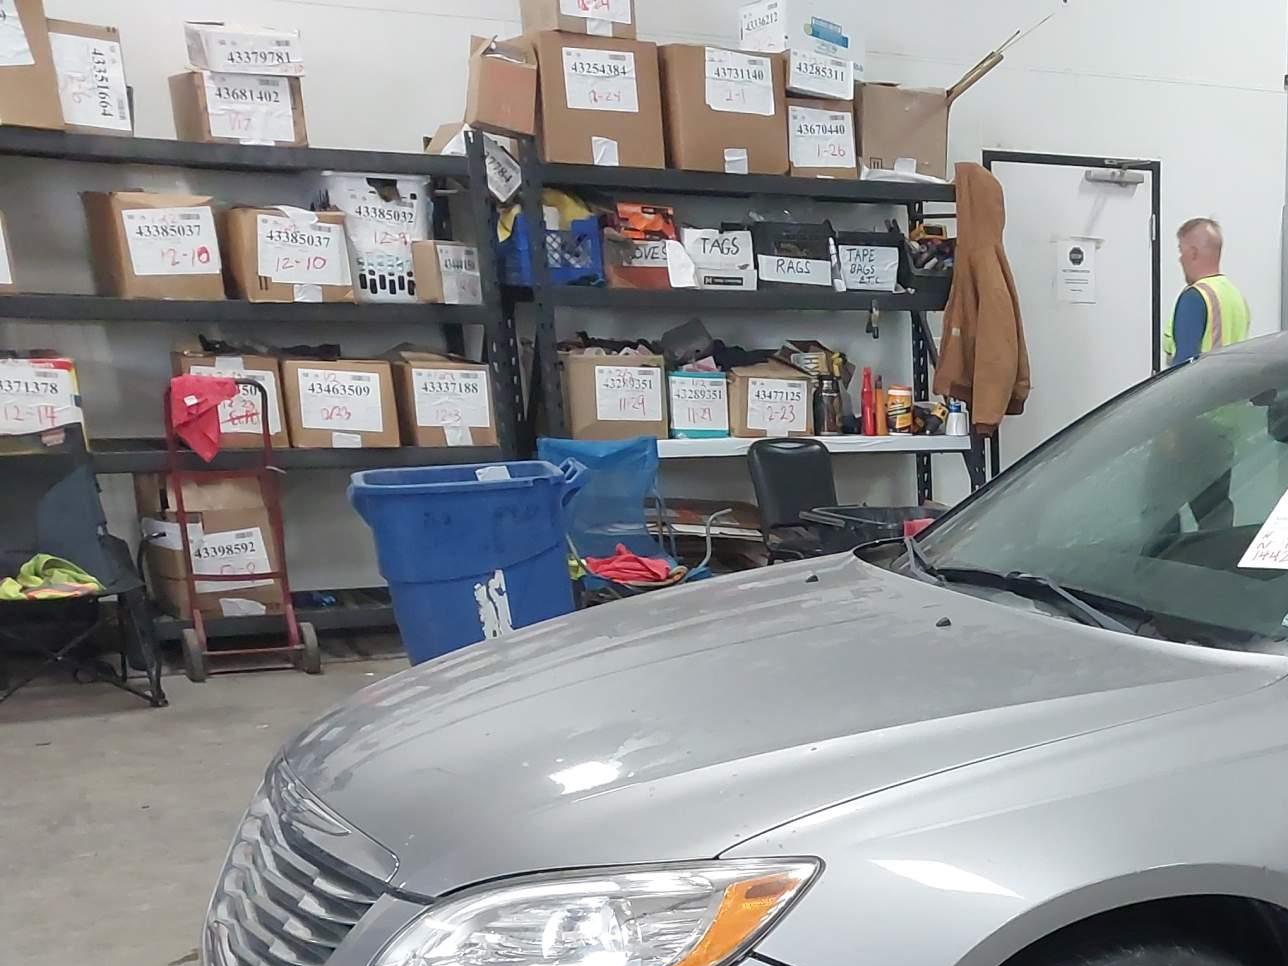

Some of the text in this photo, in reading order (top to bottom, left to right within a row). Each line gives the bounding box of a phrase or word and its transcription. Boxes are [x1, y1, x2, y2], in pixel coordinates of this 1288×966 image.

[227, 51, 292, 64] 43379781
[713, 66, 765, 82] 43731140
[215, 86, 281, 103] 43681402
[796, 123, 846, 136] 43670440
[354, 205, 415, 224] 43385032
[135, 223, 202, 239] 43385037
[265, 229, 332, 249] 43385037
[632, 241, 668, 261] OVES
[700, 236, 741, 256] TAGS
[846, 248, 876, 263] TAPE
[275, 255, 327, 273] 12-10
[776, 258, 812, 275] RAGS
[850, 263, 876, 276] BAGS
[307, 382, 371, 398] 43463509
[421, 382, 479, 395] 43337188
[754, 389, 802, 402] 43477125
[193, 541, 257, 560] 43398592
